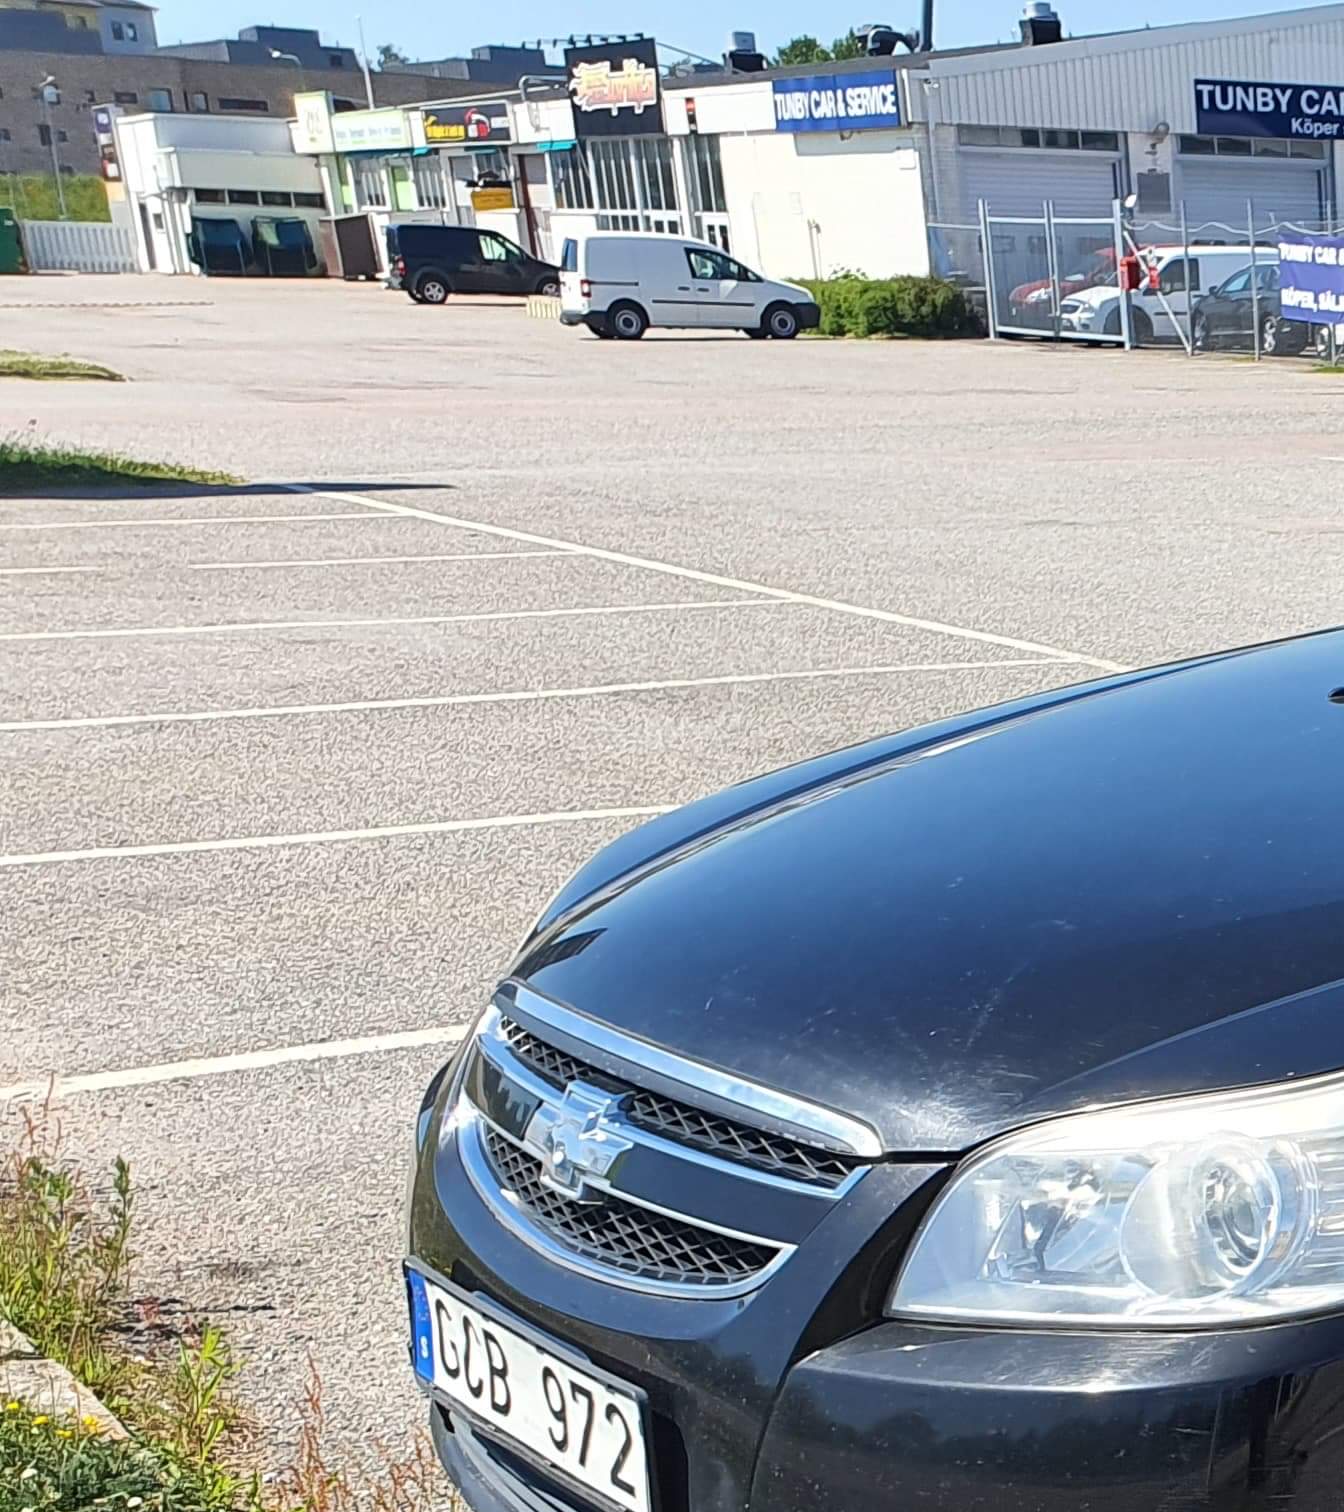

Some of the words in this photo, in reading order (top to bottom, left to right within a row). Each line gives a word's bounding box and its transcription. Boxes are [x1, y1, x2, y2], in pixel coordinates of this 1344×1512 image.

[775, 91, 809, 120] TUNBY
[810, 89, 836, 119] CAR
[836, 88, 846, 118] &
[845, 83, 897, 117] SERVICE
[1196, 84, 1293, 113] TUNBY
[1291, 117, 1340, 138] Köper
[1314, 246, 1337, 265] CAR
[420, 1335, 429, 1359] S
[435, 1298, 511, 1416] GCB
[542, 1366, 636, 1498] 972
